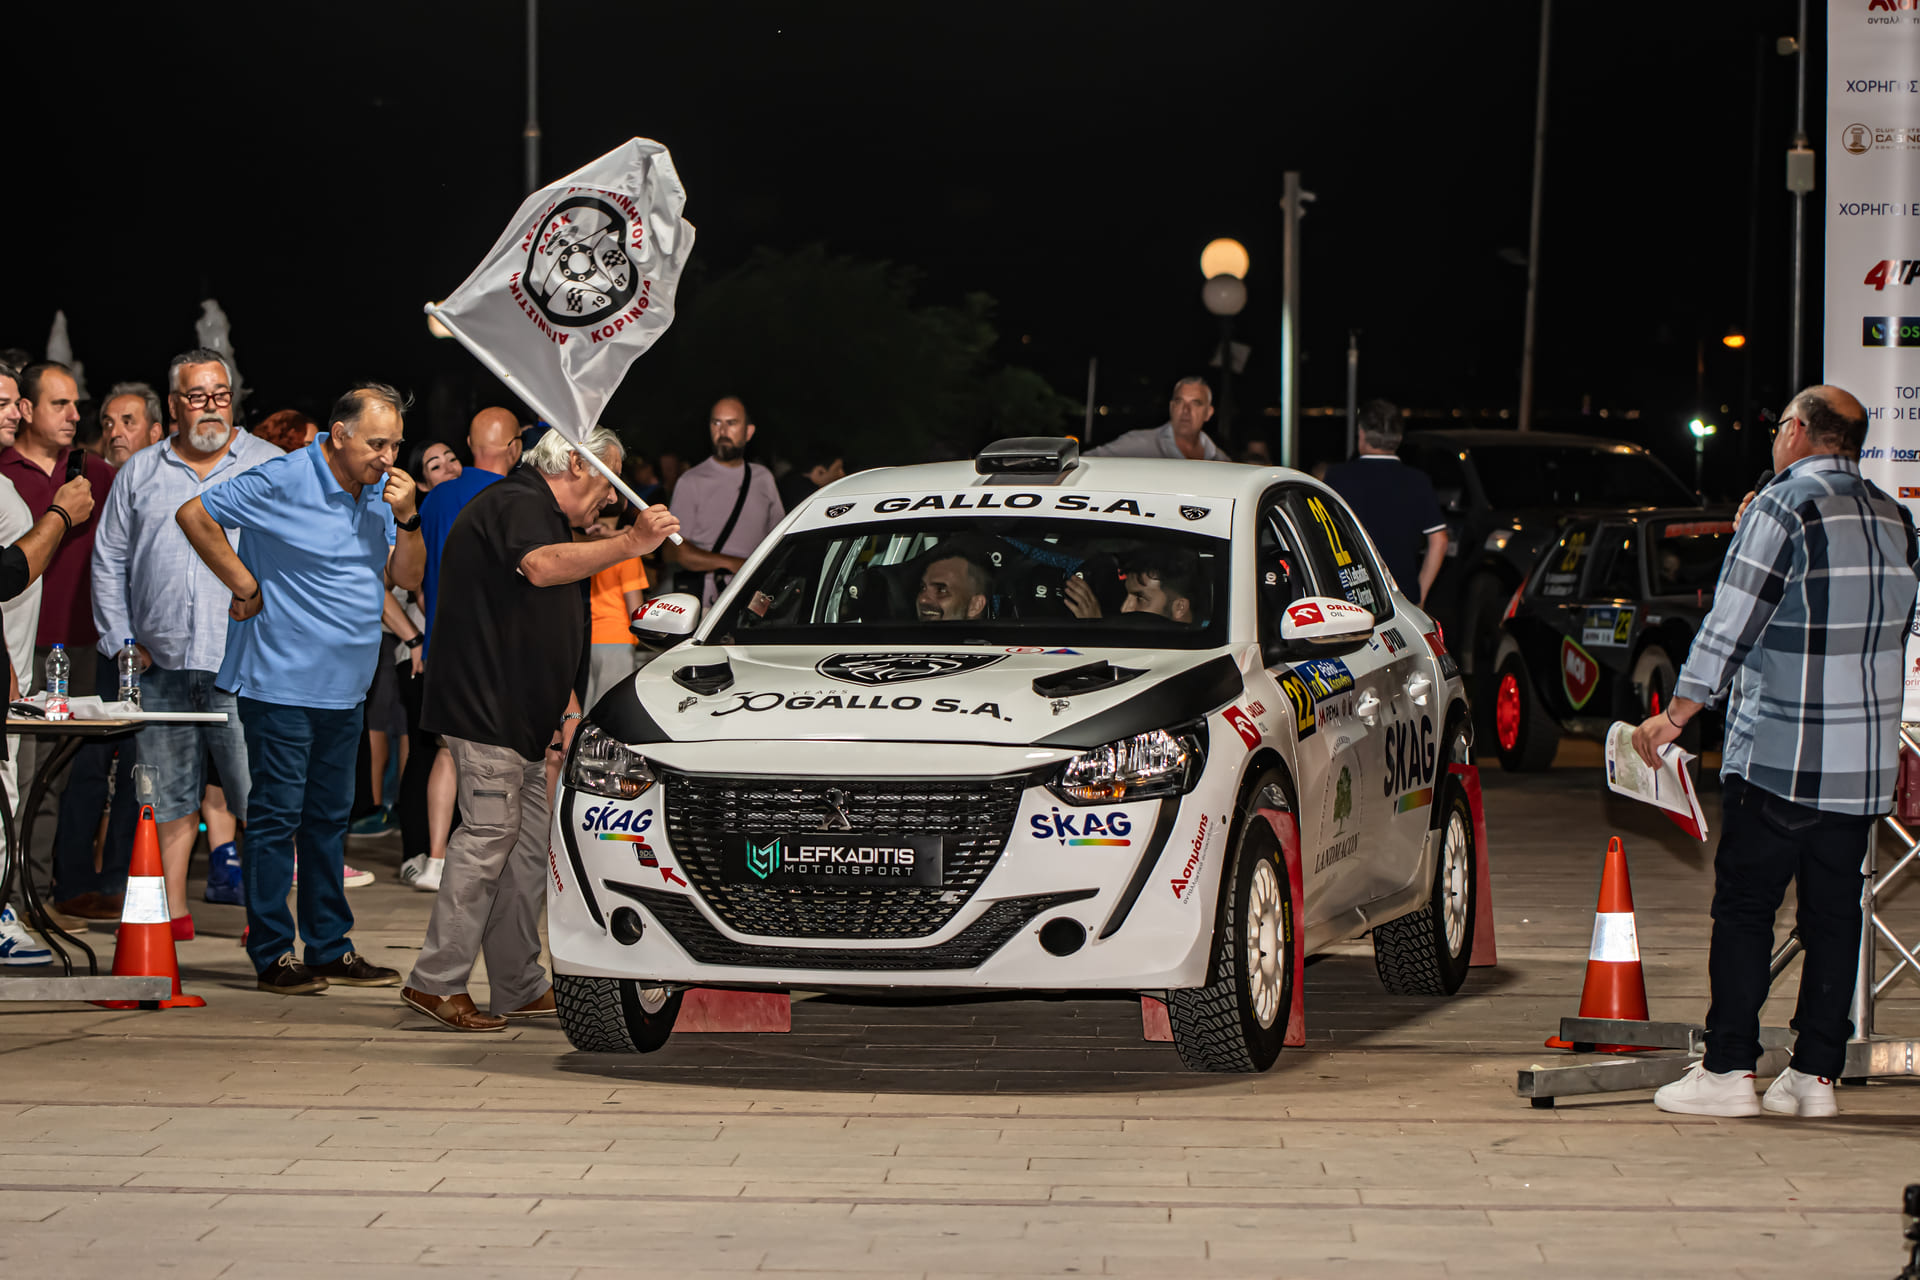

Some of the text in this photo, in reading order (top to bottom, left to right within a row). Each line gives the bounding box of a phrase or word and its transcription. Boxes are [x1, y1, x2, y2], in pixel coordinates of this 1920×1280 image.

[591, 272, 628, 309] 19 87
[873, 492, 1158, 518] GALLO S.A.
[1306, 496, 1352, 567] 22
[656, 602, 686, 615] ORLEN
[1326, 604, 1364, 614] ORLEN
[709, 691, 1014, 723] 50 GALLO S.A.
[790, 688, 850, 697] YEARS
[1282, 675, 1315, 733] 22
[1383, 702, 1435, 798] SKAG
[582, 800, 654, 833] SKAG
[1030, 807, 1132, 840] SKAG
[783, 864, 915, 877] MOTORSPORT
[784, 845, 915, 866] LEFKADITIS
